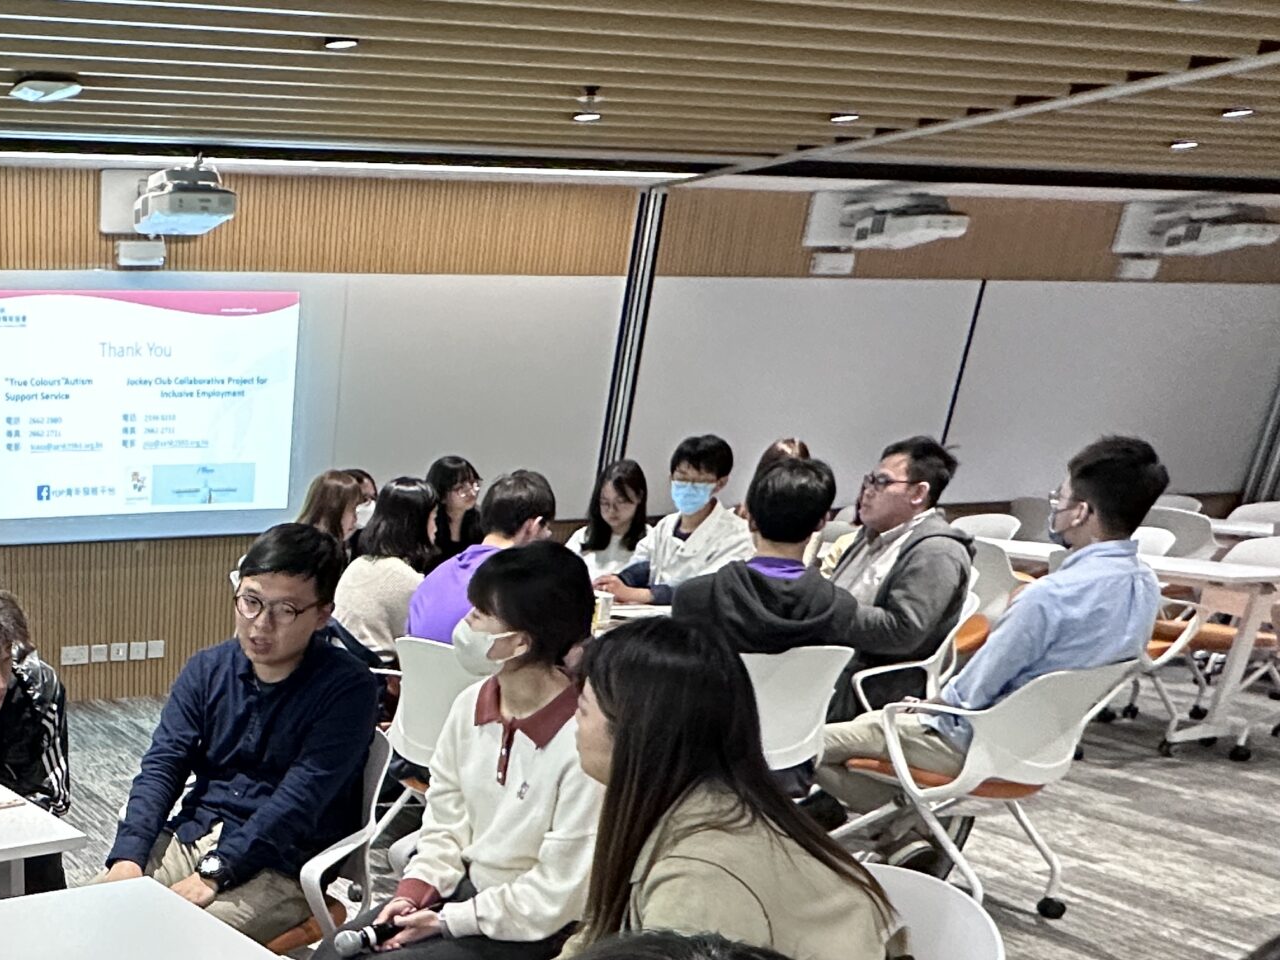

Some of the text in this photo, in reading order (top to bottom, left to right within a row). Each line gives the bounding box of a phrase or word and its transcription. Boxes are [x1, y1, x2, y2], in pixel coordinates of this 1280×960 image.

[99, 342, 172, 358] Thank You
[126, 375, 269, 387] Jockey Club Collaborative Project for
[4, 391, 70, 403] Support Service
[160, 389, 246, 399] Inclusive Employment
